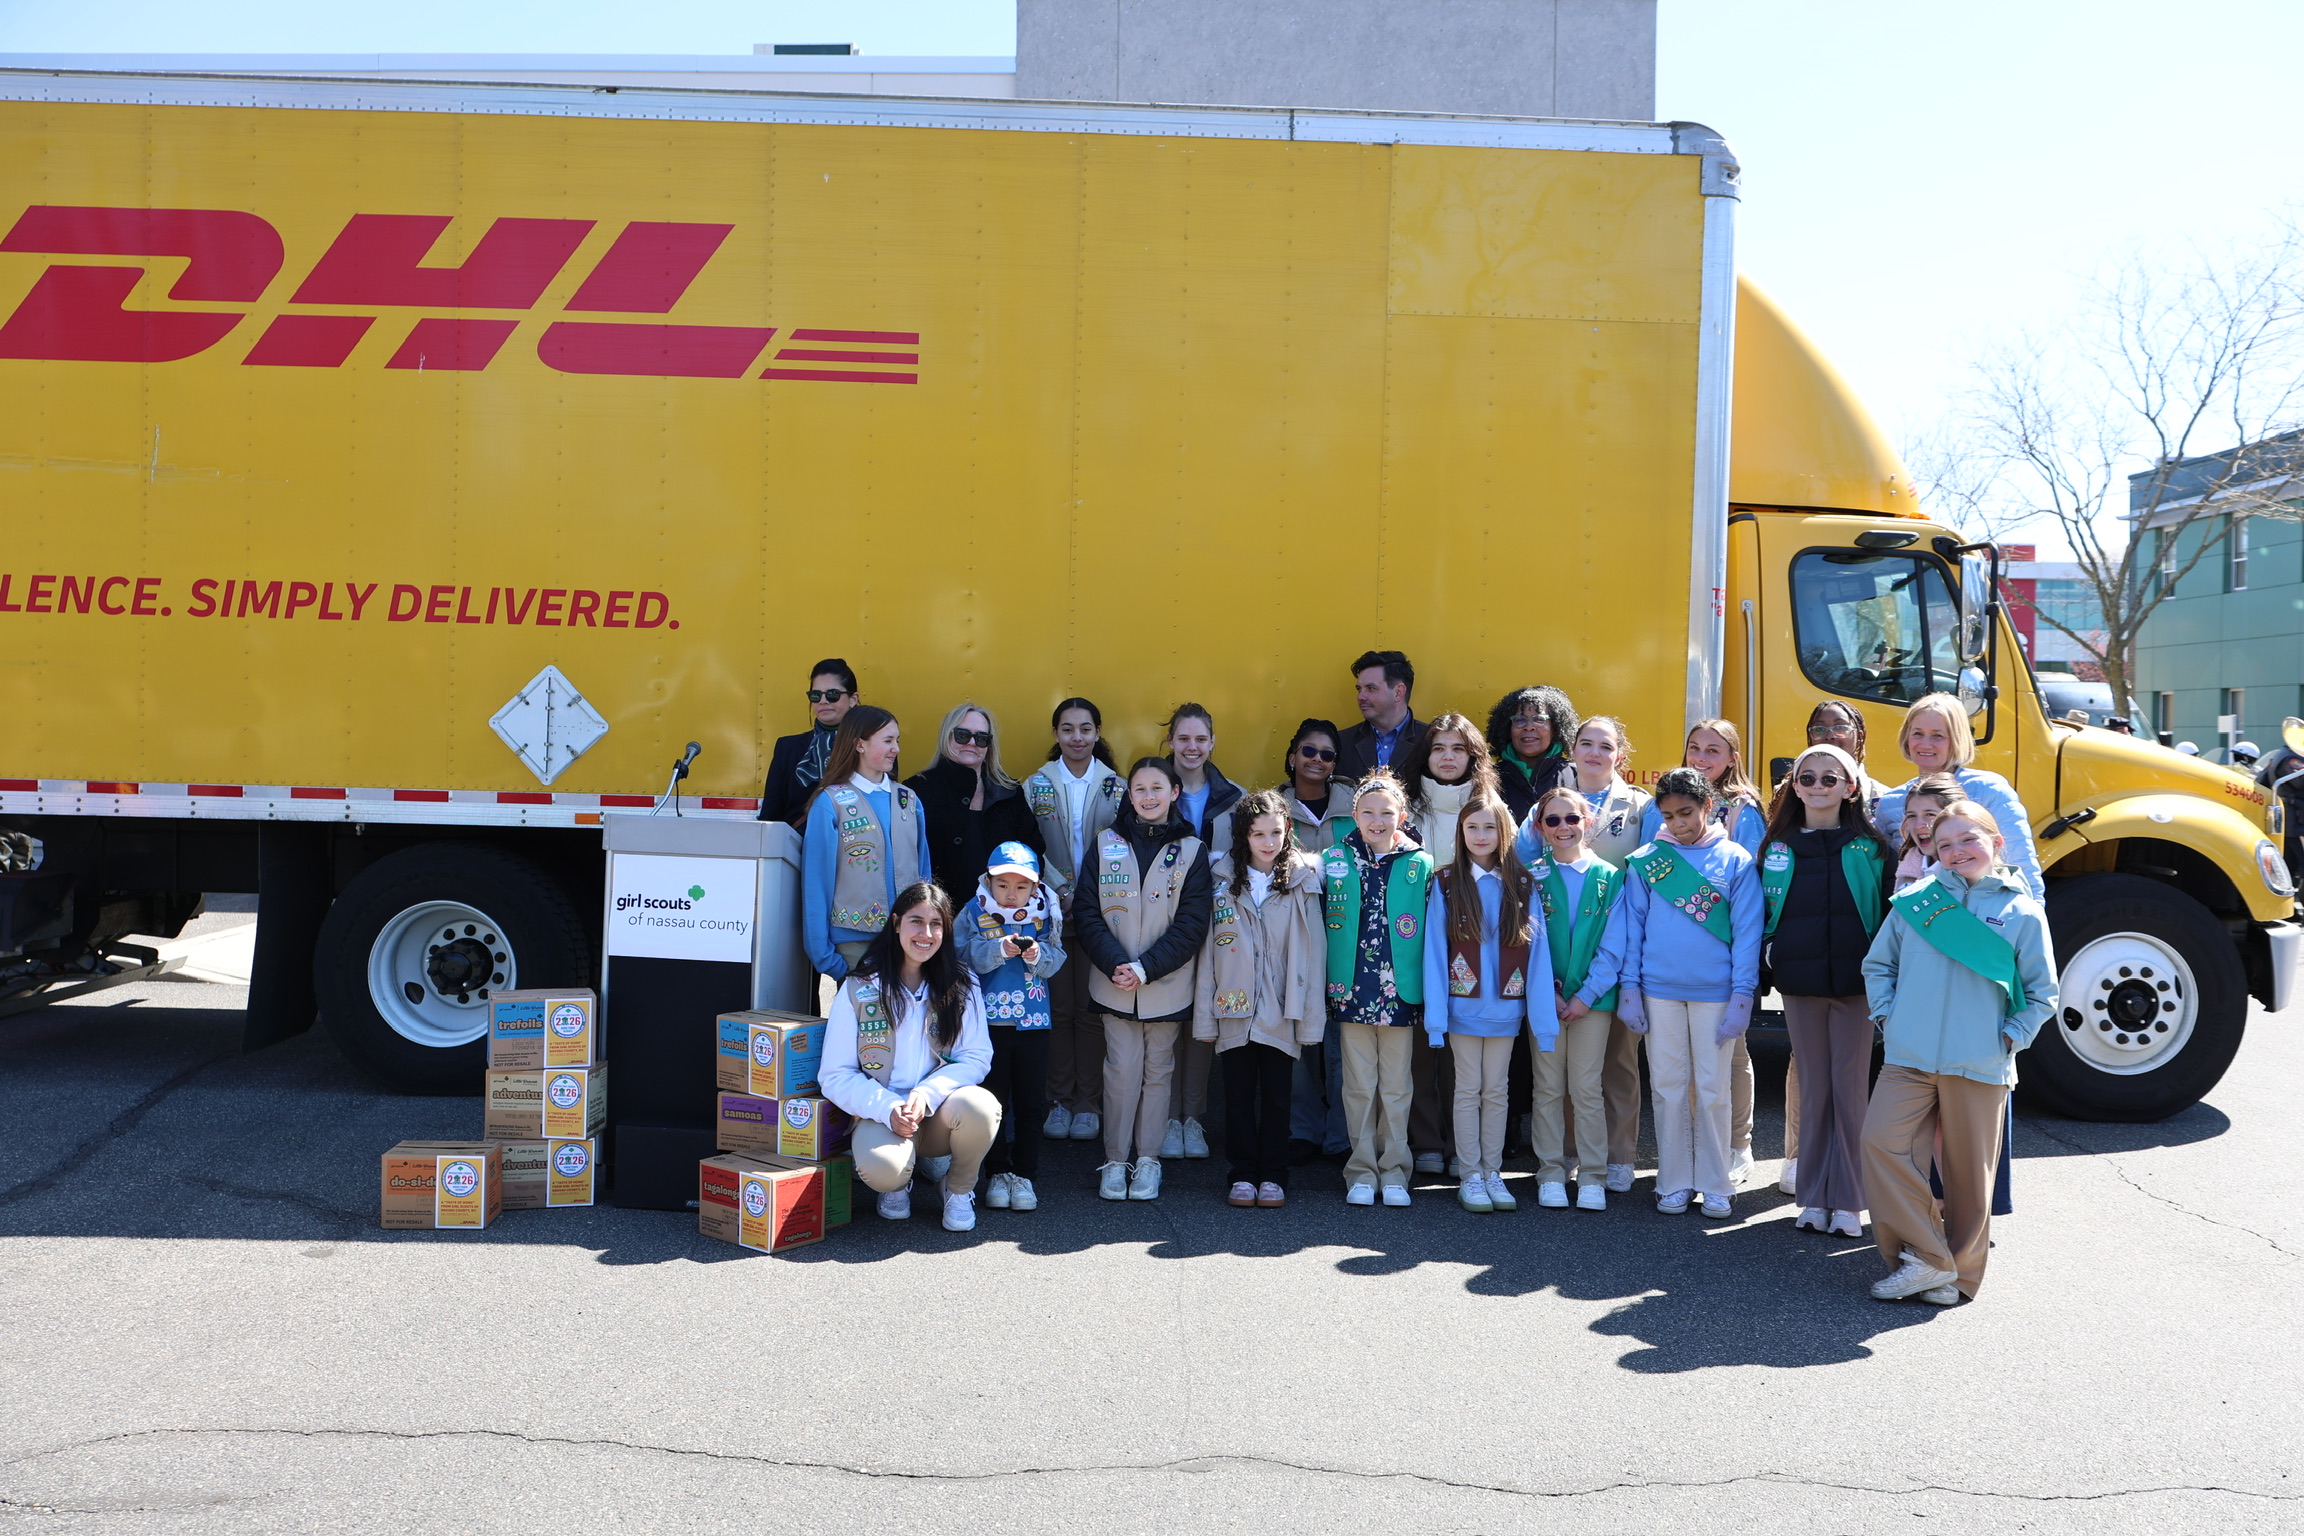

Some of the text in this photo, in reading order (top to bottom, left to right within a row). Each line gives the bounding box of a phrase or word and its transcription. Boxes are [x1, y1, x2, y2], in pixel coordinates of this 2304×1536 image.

[0, 205, 778, 380] DHL
[187, 577, 378, 622] SIMPLY
[387, 583, 681, 631] DELIVERED.
[2224, 780, 2265, 806] 534008
[843, 817, 868, 830] 3751
[1644, 857, 1664, 871] 821
[616, 893, 692, 911] girl scouts
[1911, 893, 1940, 912] 821
[628, 911, 749, 936] of nassau county
[498, 1017, 543, 1031] trefoils
[555, 1016, 581, 1027] 226
[860, 1020, 887, 1031] 3555
[720, 1039, 748, 1052] trefoils
[755, 1044, 772, 1056] 226
[553, 1088, 577, 1098] 226
[724, 1109, 762, 1121] samoas
[788, 1106, 809, 1117] 226
[502, 1159, 547, 1170] dventu
[559, 1156, 584, 1166] 226
[447, 1175, 474, 1185] 226
[747, 1194, 764, 1206] 226
[784, 1230, 812, 1242] tagalongs
